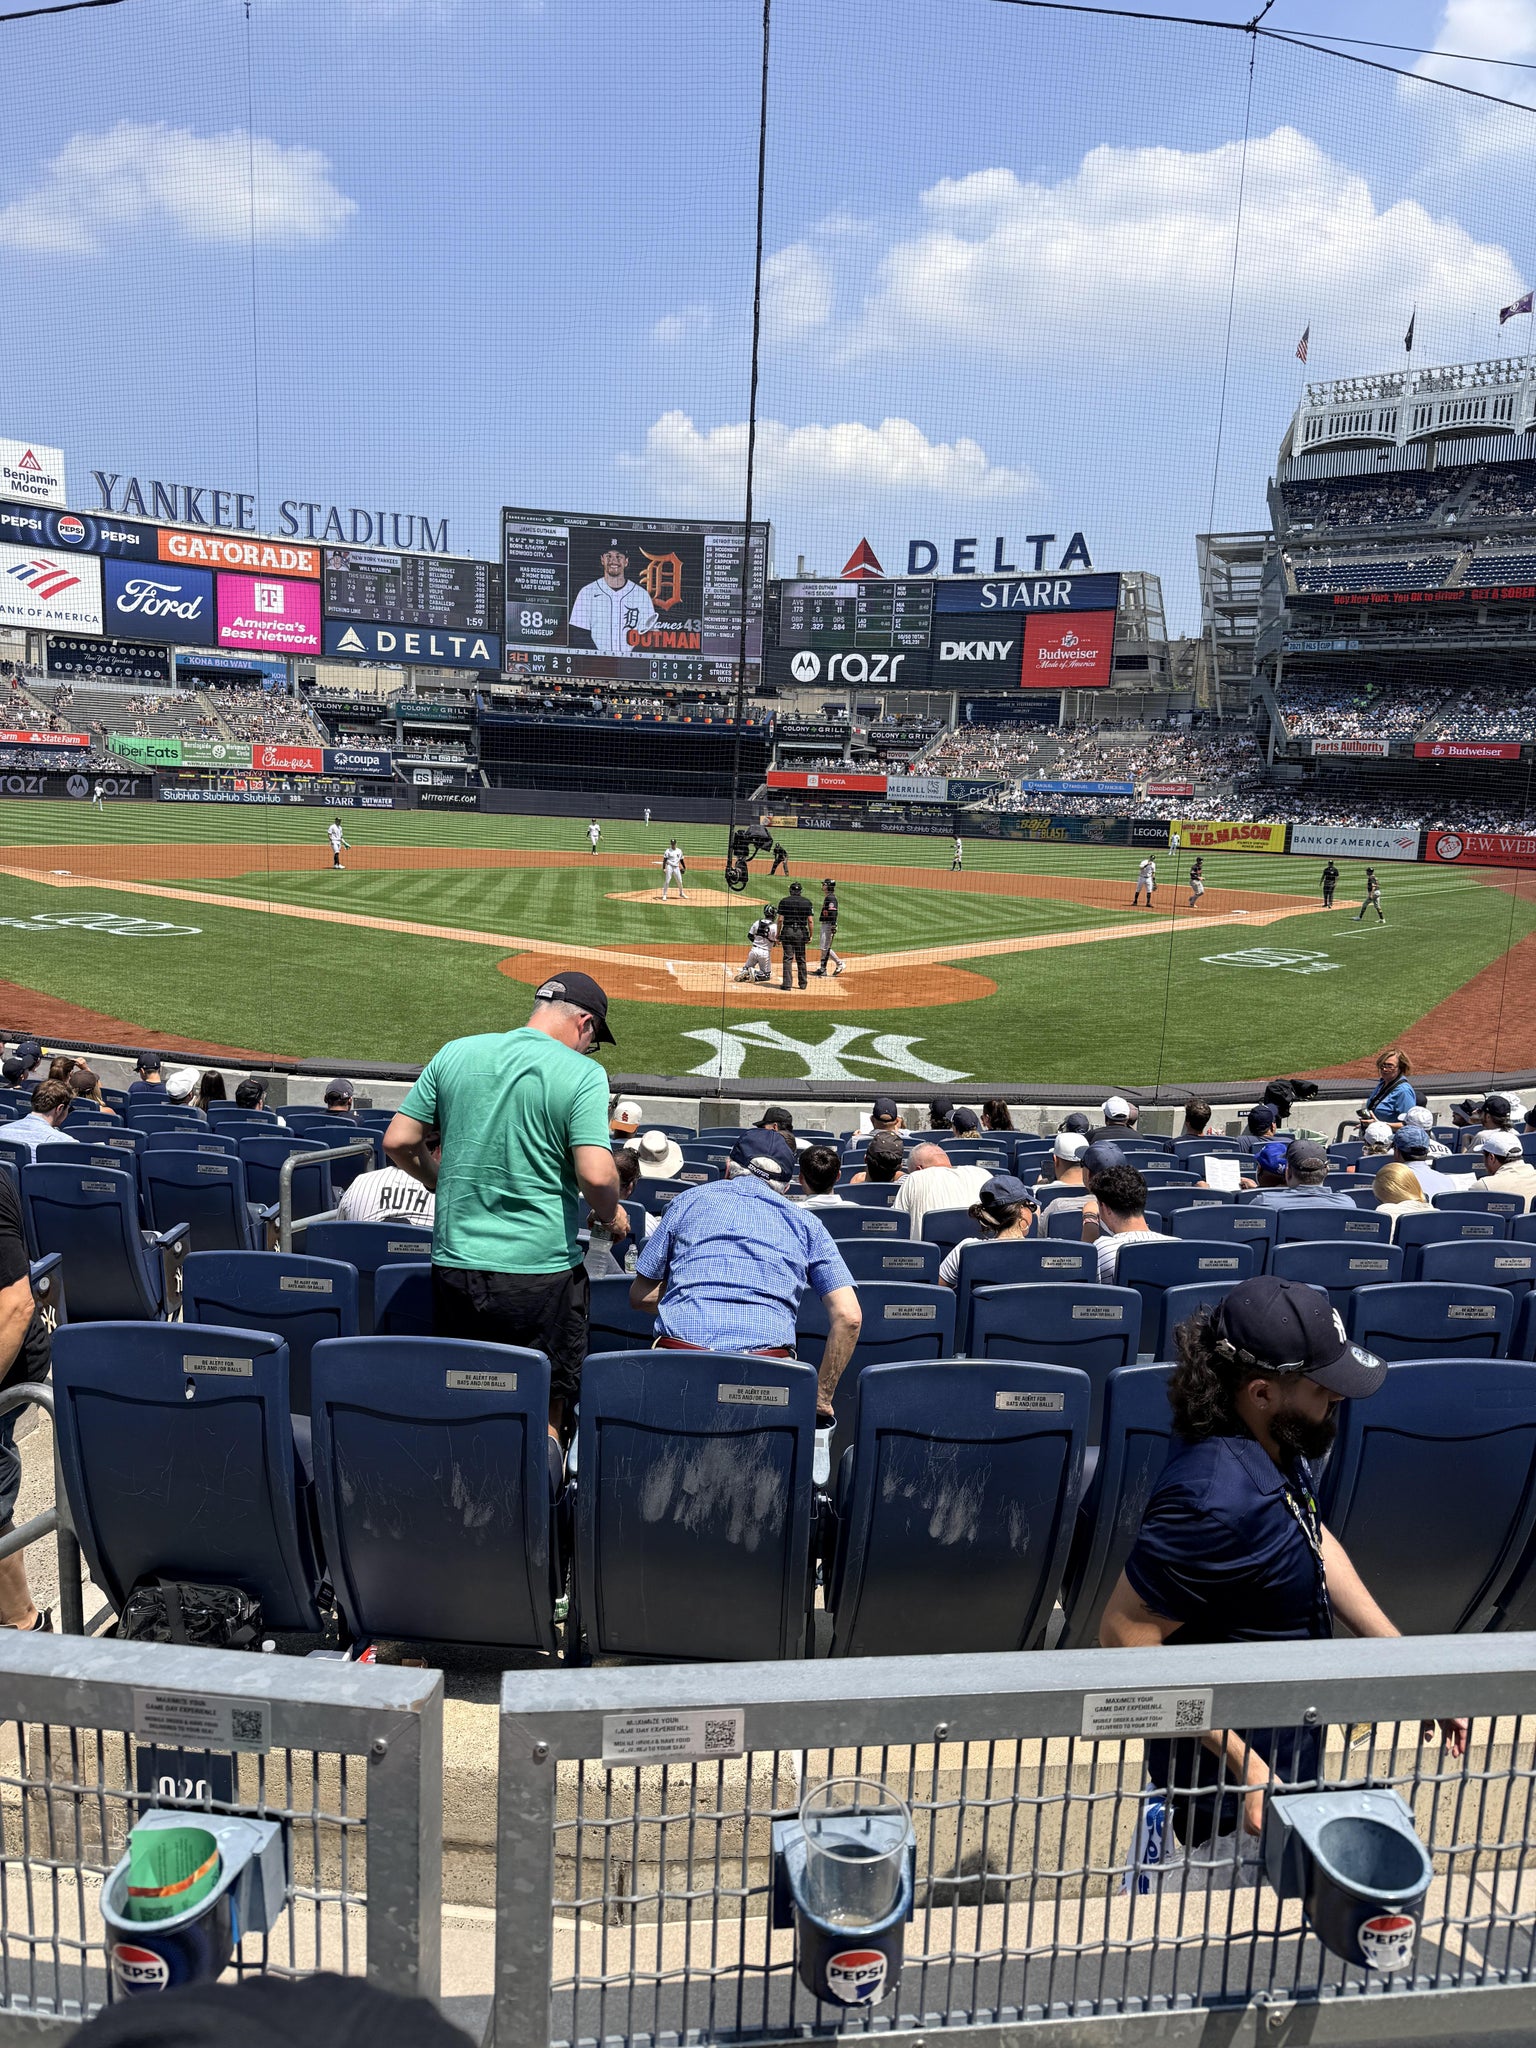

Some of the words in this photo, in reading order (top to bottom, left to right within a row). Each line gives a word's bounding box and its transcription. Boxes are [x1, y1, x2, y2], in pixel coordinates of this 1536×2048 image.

[3, 467, 57, 487] Benjamin
[11, 481, 49, 496] Moore
[90, 470, 255, 531] YANKEE
[1, 514, 42, 530] PEPSI
[279, 500, 450, 552] STADIUM
[60, 525, 83, 535] PEPSI
[101, 530, 140, 545] PEPSI
[168, 535, 313, 573] GATORADE
[907, 531, 1092, 576] DELTA
[117, 579, 204, 620] Ford
[980, 580, 1072, 608] STARR
[1471, 590, 1488, 600] GET
[28, 608, 42, 618] OF
[45, 610, 100, 624] AMERICA
[466, 617, 483, 626] 1:59
[520, 610, 543, 628] 88
[232, 616, 306, 633] America's
[684, 618, 701, 632] 43
[221, 625, 258, 641] Best
[260, 629, 318, 646] Network
[521, 628, 554, 637] CHANGEUP
[627, 629, 701, 649] OUTMAN
[376, 630, 490, 660] DELTA
[940, 641, 1013, 661] DKNY
[1320, 641, 1331, 649] CUP
[83, 652, 98, 661] New
[97, 653, 111, 664] York
[111, 655, 134, 665] Yankees
[533, 654, 545, 662] DET
[1037, 648, 1099, 660] Budweiser
[190, 656, 213, 666] KONA
[214, 658, 229, 667] BIG
[532, 664, 546, 672] NYY
[552, 660, 558, 668] 2
[827, 653, 905, 683] razr
[1036, 659, 1059, 669] Made
[1059, 661, 1066, 670] of
[1065, 659, 1096, 668] America
[312, 702, 343, 710] COLONY
[352, 705, 383, 713] GRILL
[440, 707, 469, 715] GRILL
[112, 743, 143, 757] Uber
[146, 745, 179, 758] Eats
[1315, 742, 1339, 751] Parts
[1340, 740, 1385, 753] Authority
[1448, 746, 1503, 757] Budweiser
[262, 746, 314, 769] Chick-fil-A
[348, 754, 380, 767] coupa
[416, 773, 430, 782] GS
[820, 777, 846, 785] TOYOTA
[0, 775, 47, 794] razr
[888, 784, 926, 794] MERRILL
[1149, 785, 1176, 793] Reebok
[163, 791, 200, 801] StubHub
[202, 791, 240, 802] StubHub
[243, 793, 280, 803] StubHub
[325, 796, 354, 806] STARR
[361, 797, 392, 805] CUTWATER
[421, 793, 477, 804] NITTOTIRE.COM
[804, 818, 832, 829] STARR
[880, 823, 905, 832] StubHub
[907, 824, 930, 833] StubHub
[931, 825, 954, 834] StubHub
[1041, 827, 1066, 839] BLAST
[1133, 827, 1169, 838] LEGORA
[1293, 836, 1323, 846] BANK
[1324, 837, 1339, 846] OF
[1340, 838, 1391, 849] AMERICA
[1465, 836, 1495, 852] F.W.
[379, 1186, 430, 1213] RUTH
[145, 1703, 165, 1712] GAME
[1362, 1929, 1414, 1945] PEPSI
[830, 1962, 884, 1982] PEPSI
